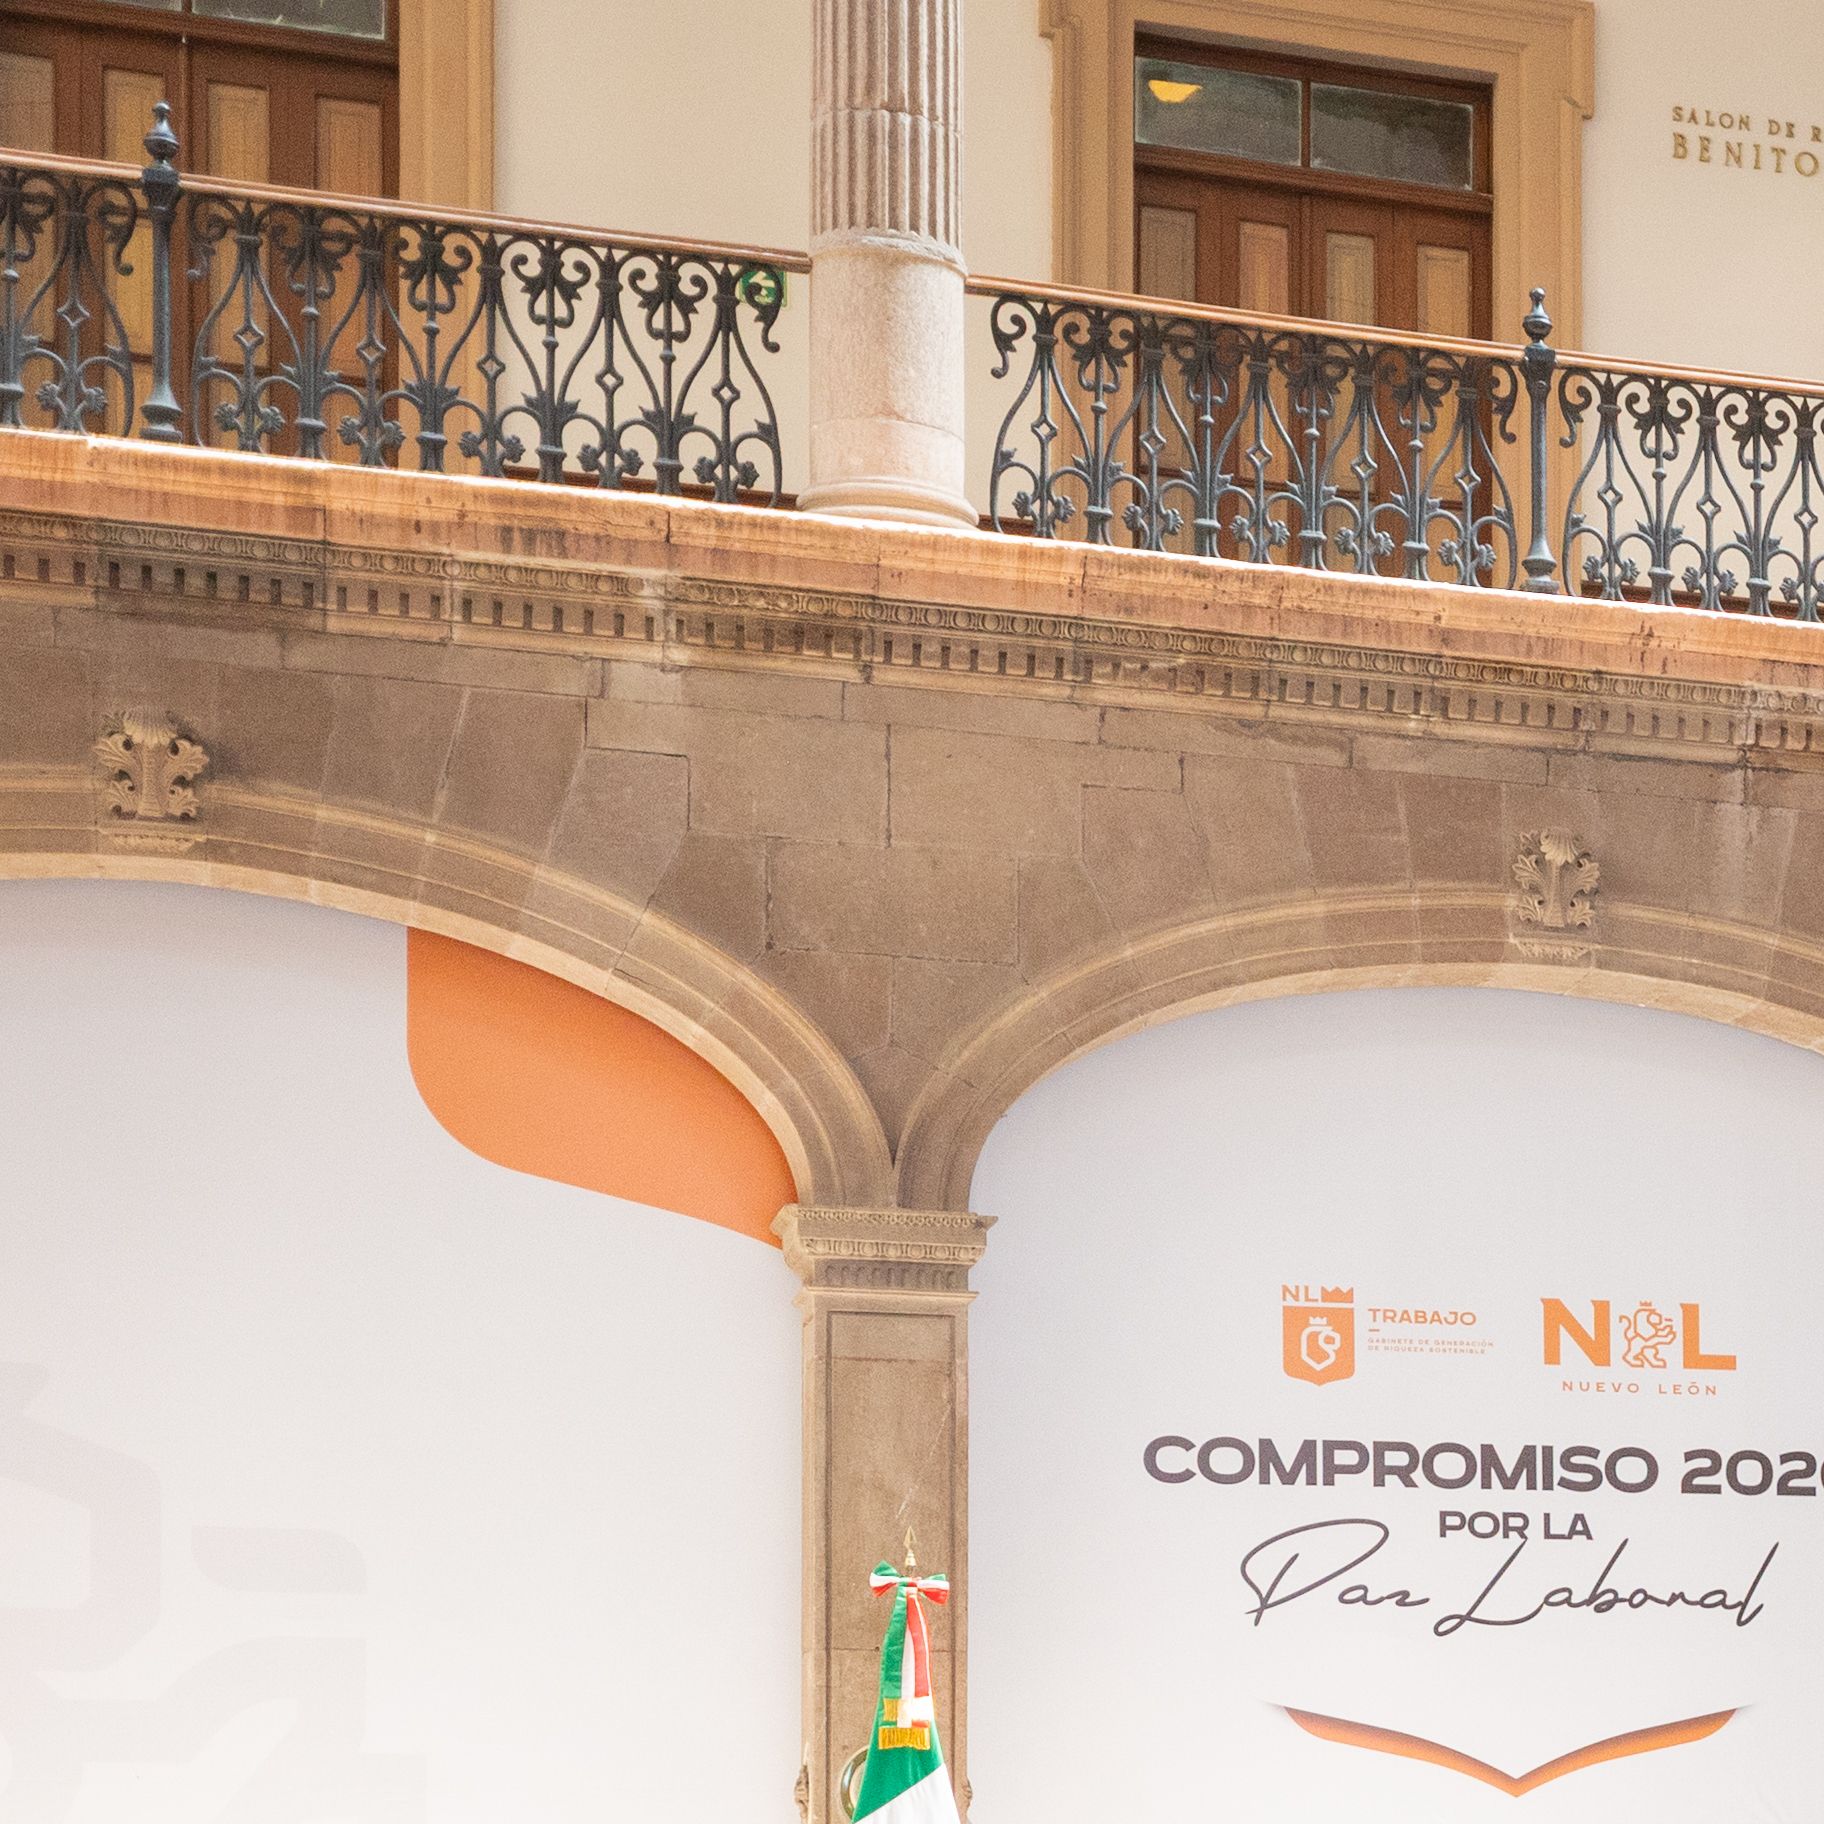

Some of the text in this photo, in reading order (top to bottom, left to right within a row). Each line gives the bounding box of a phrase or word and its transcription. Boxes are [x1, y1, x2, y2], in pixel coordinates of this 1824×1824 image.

[1672, 106, 1751, 132] SALON
[1768, 119, 1796, 139] DE
[1672, 132, 1820, 178] BENITO
[1367, 1308, 1477, 1326] TRABAJO
[1562, 1381, 1640, 1394] NUEVO
[1142, 1434, 1660, 1494] COMPROMISO
[1438, 1510, 1594, 1542] POR LA
[1240, 1517, 1780, 1637] Paz Laboral
